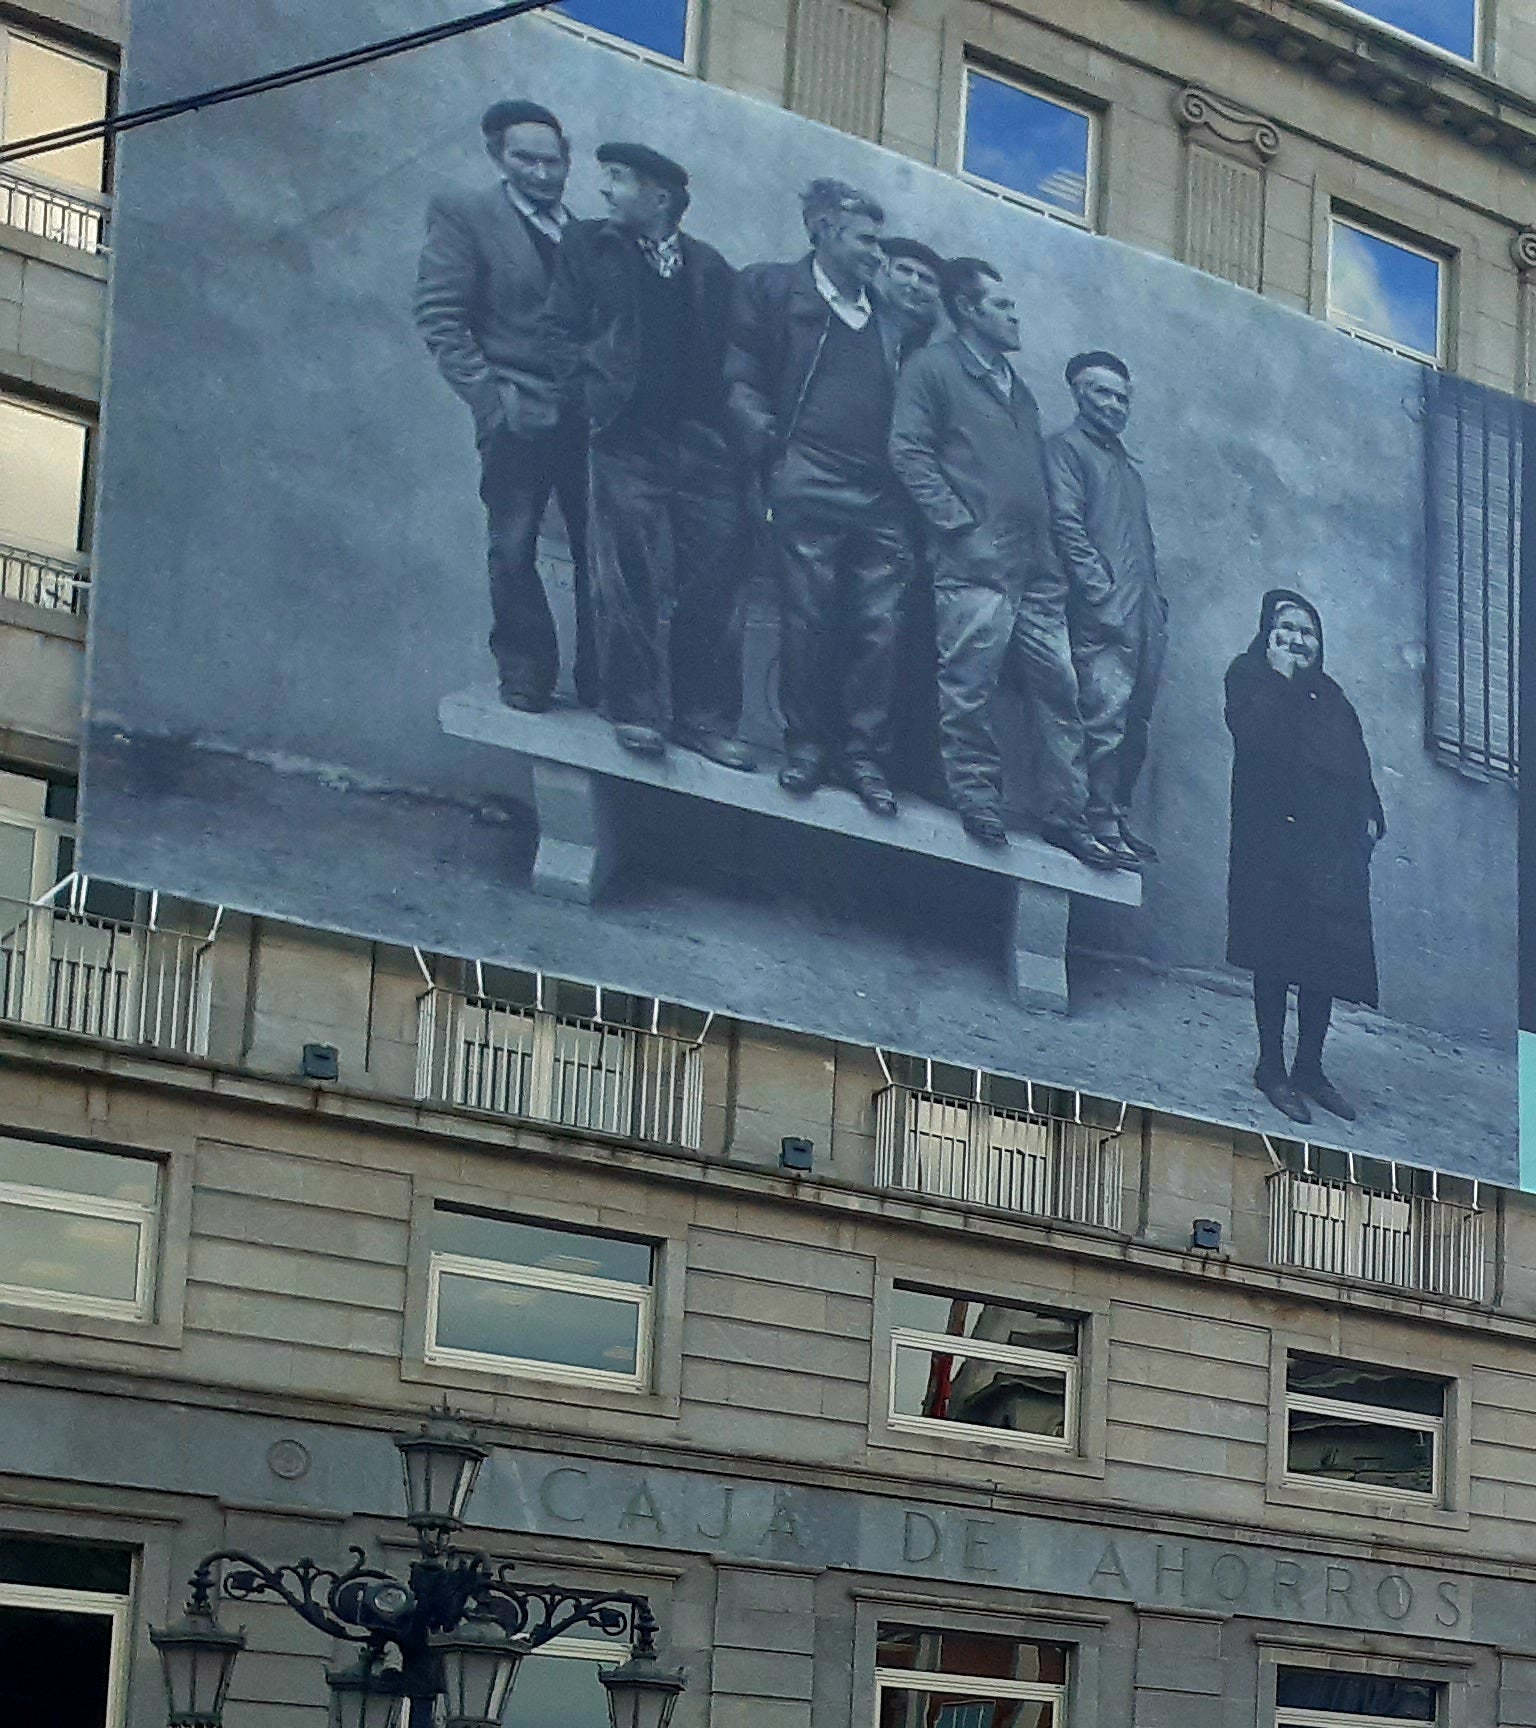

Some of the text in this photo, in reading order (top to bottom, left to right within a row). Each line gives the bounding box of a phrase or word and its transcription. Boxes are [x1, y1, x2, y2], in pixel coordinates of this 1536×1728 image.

[540, 1467, 806, 1551] CAJA
[902, 1510, 998, 1573] DE
[1089, 1541, 1462, 1627] AHORROS
